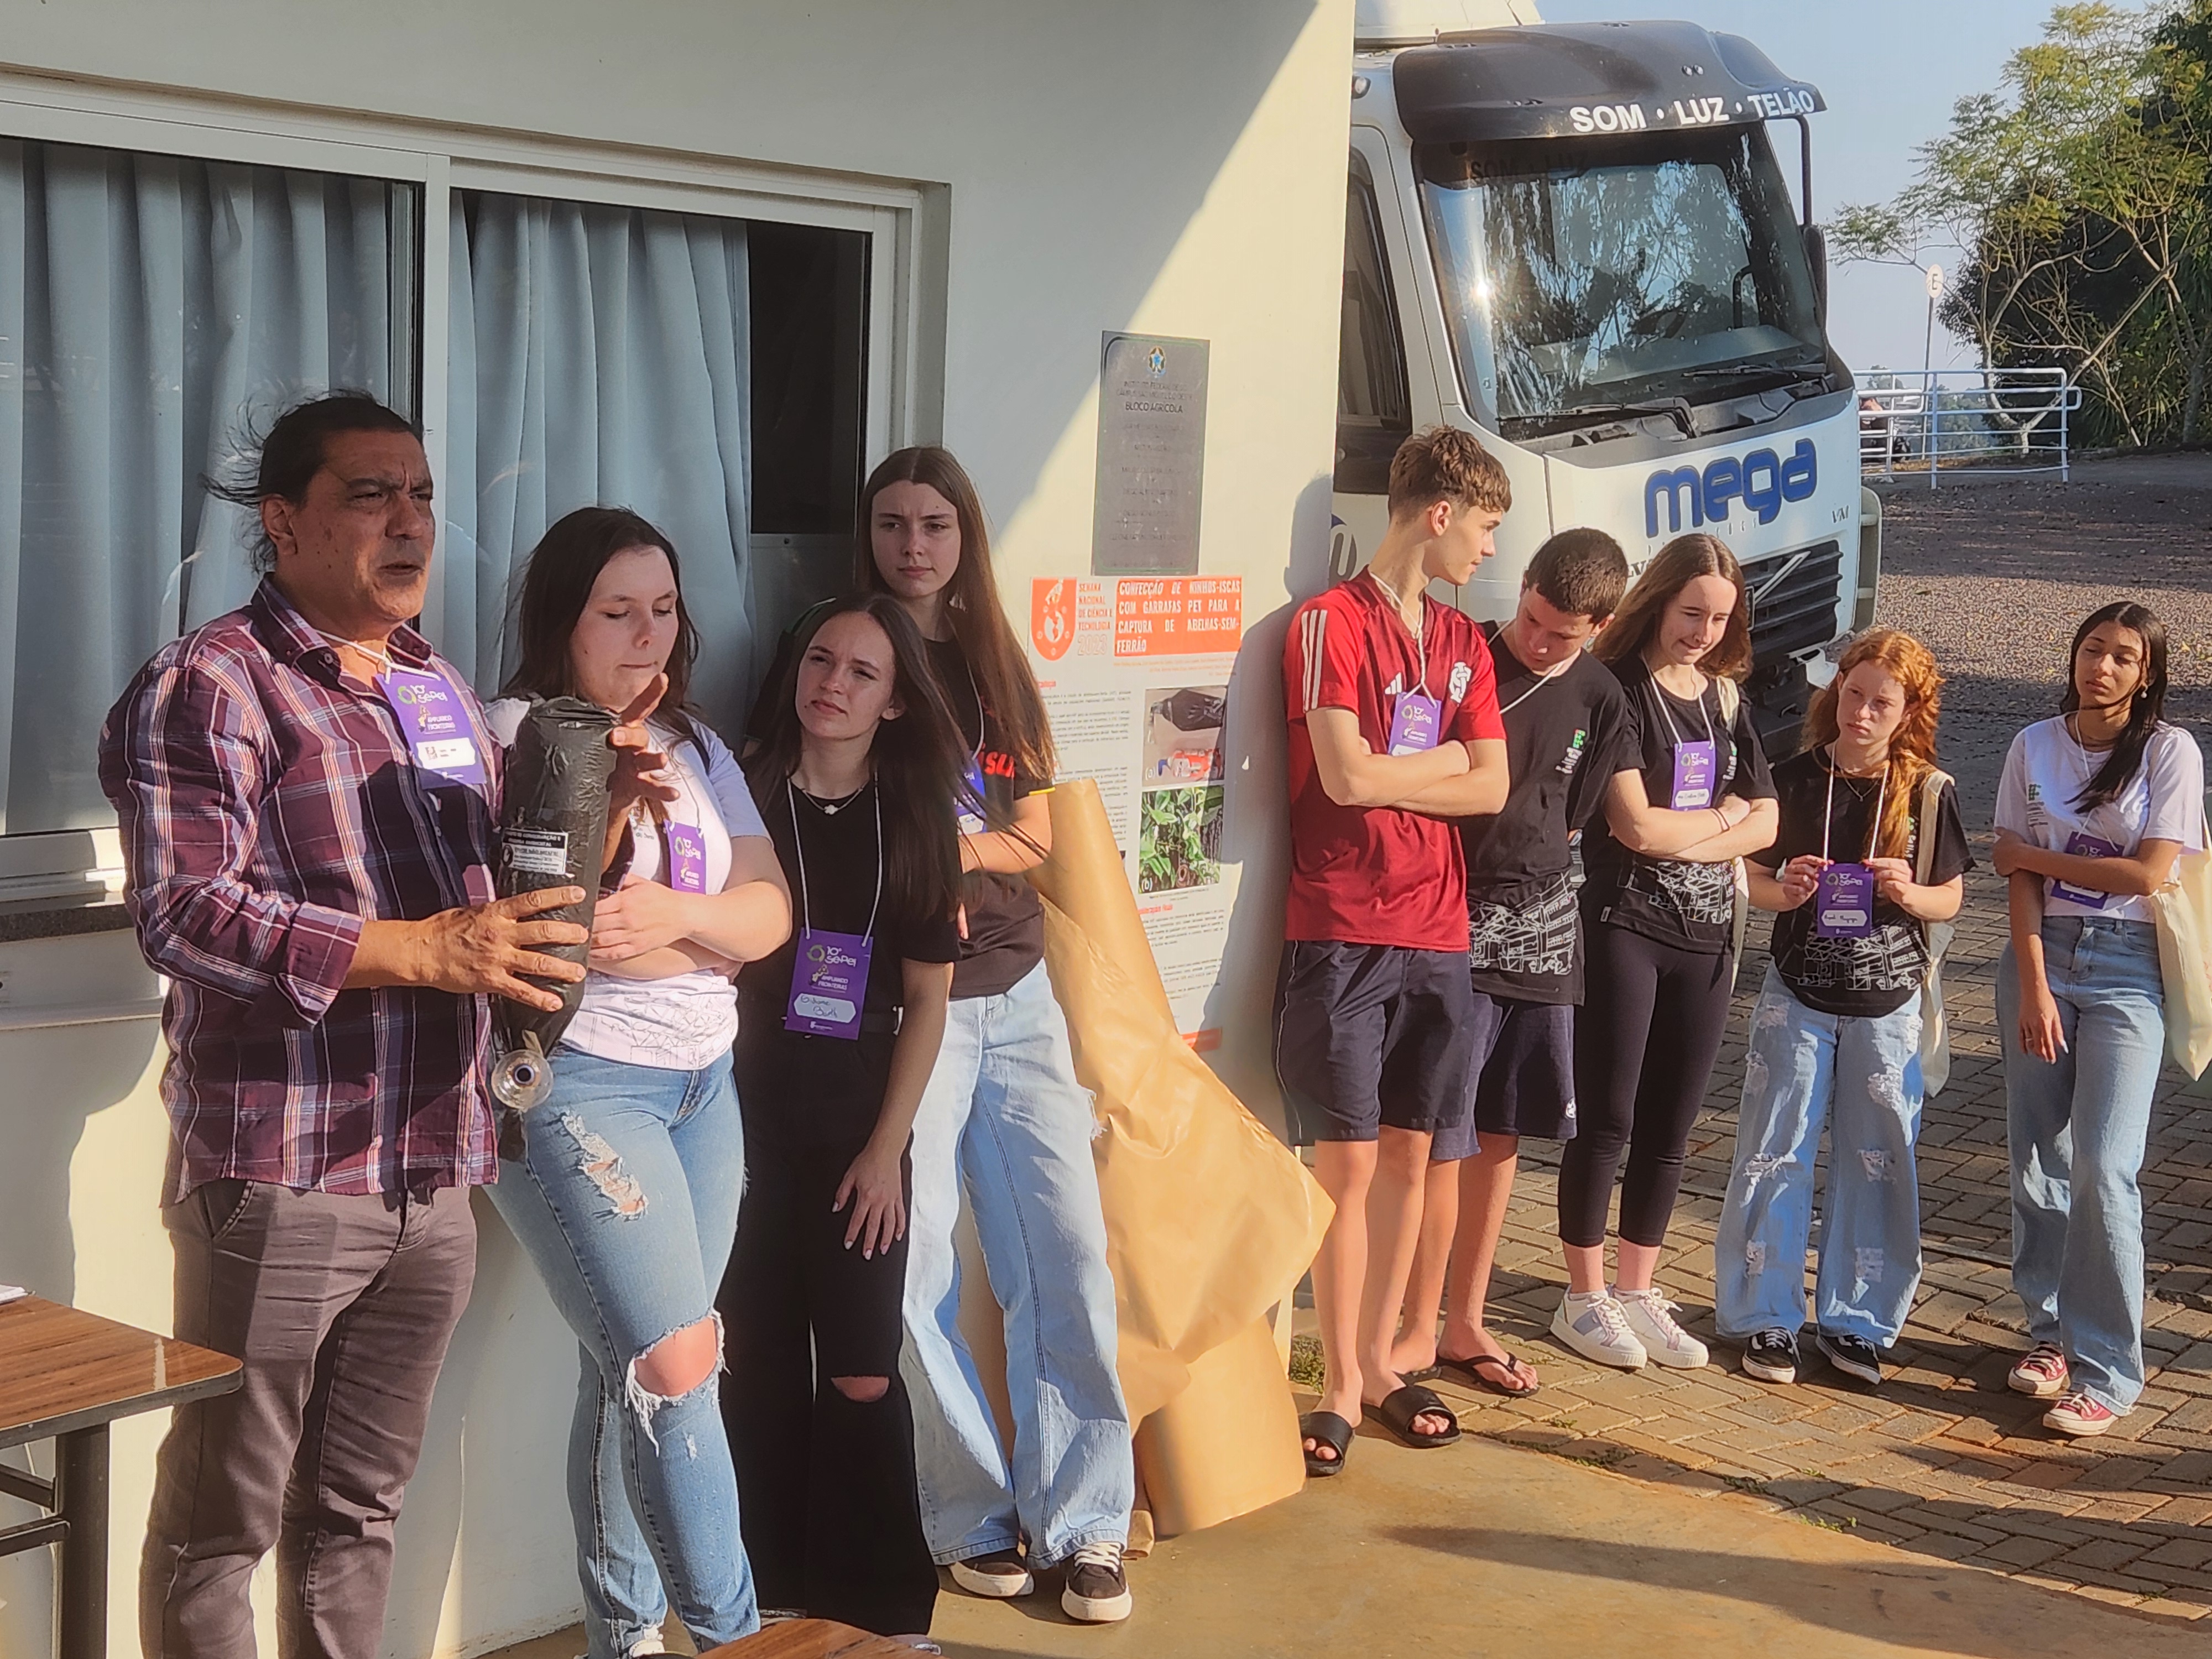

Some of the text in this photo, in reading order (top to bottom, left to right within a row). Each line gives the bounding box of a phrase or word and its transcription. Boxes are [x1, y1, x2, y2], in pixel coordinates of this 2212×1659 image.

[1569, 87, 1814, 132] SOM LUZ TELÃO
[1125, 401, 1149, 411] BLOCO
[1645, 437, 1817, 539] mega
[1079, 583, 1101, 592] SEMANA
[1119, 579, 1240, 599] CONFECÇÃO DE NINHOS-ISCAS
[1119, 598, 1240, 614] COM GARRAFAS PET PARA A
[1078, 621, 1110, 630] TECNOLOGIA
[1118, 620, 1152, 634] CAPTURA
[1165, 619, 1175, 632] DE
[1078, 634, 1107, 656] 2023
[1117, 636, 1146, 654] FERRÃO
[1141, 877, 1153, 893] (b)
